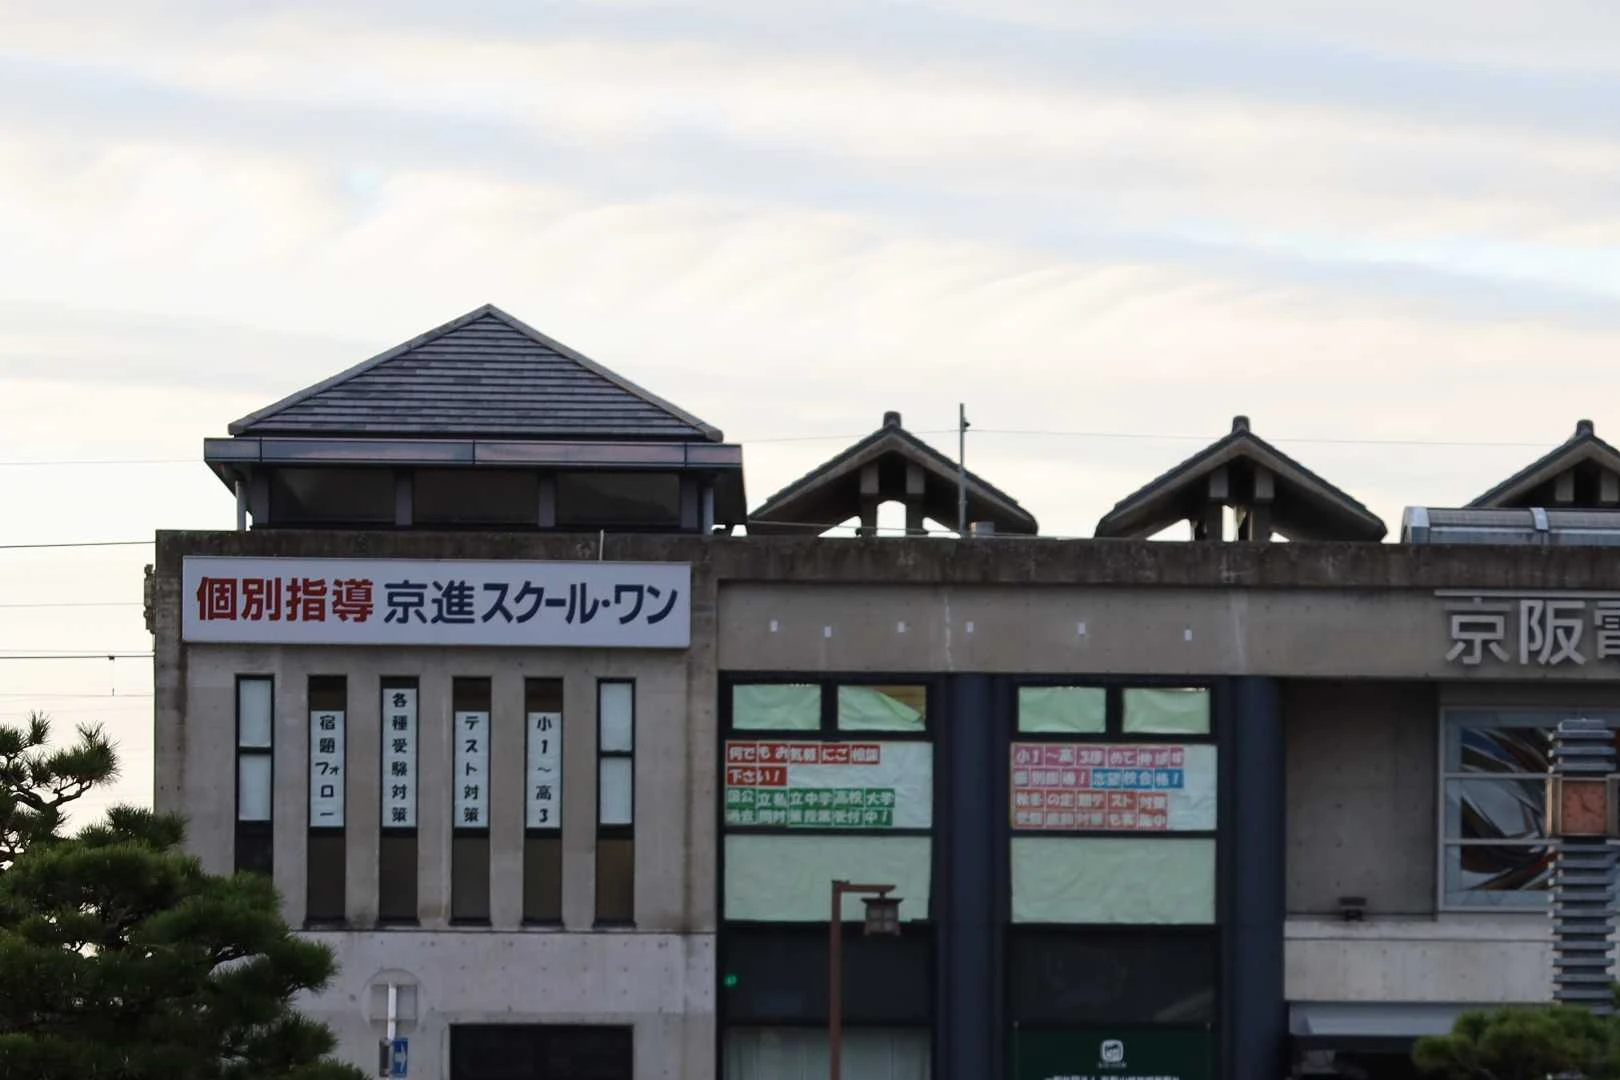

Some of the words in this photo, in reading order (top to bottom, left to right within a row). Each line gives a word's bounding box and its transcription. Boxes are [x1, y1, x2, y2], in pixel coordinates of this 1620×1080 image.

[196, 576, 374, 623] 個別指導
[314, 714, 340, 816] 宿題フォロー
[391, 692, 408, 823] 各種受験対策
[463, 715, 480, 823] テスト対策
